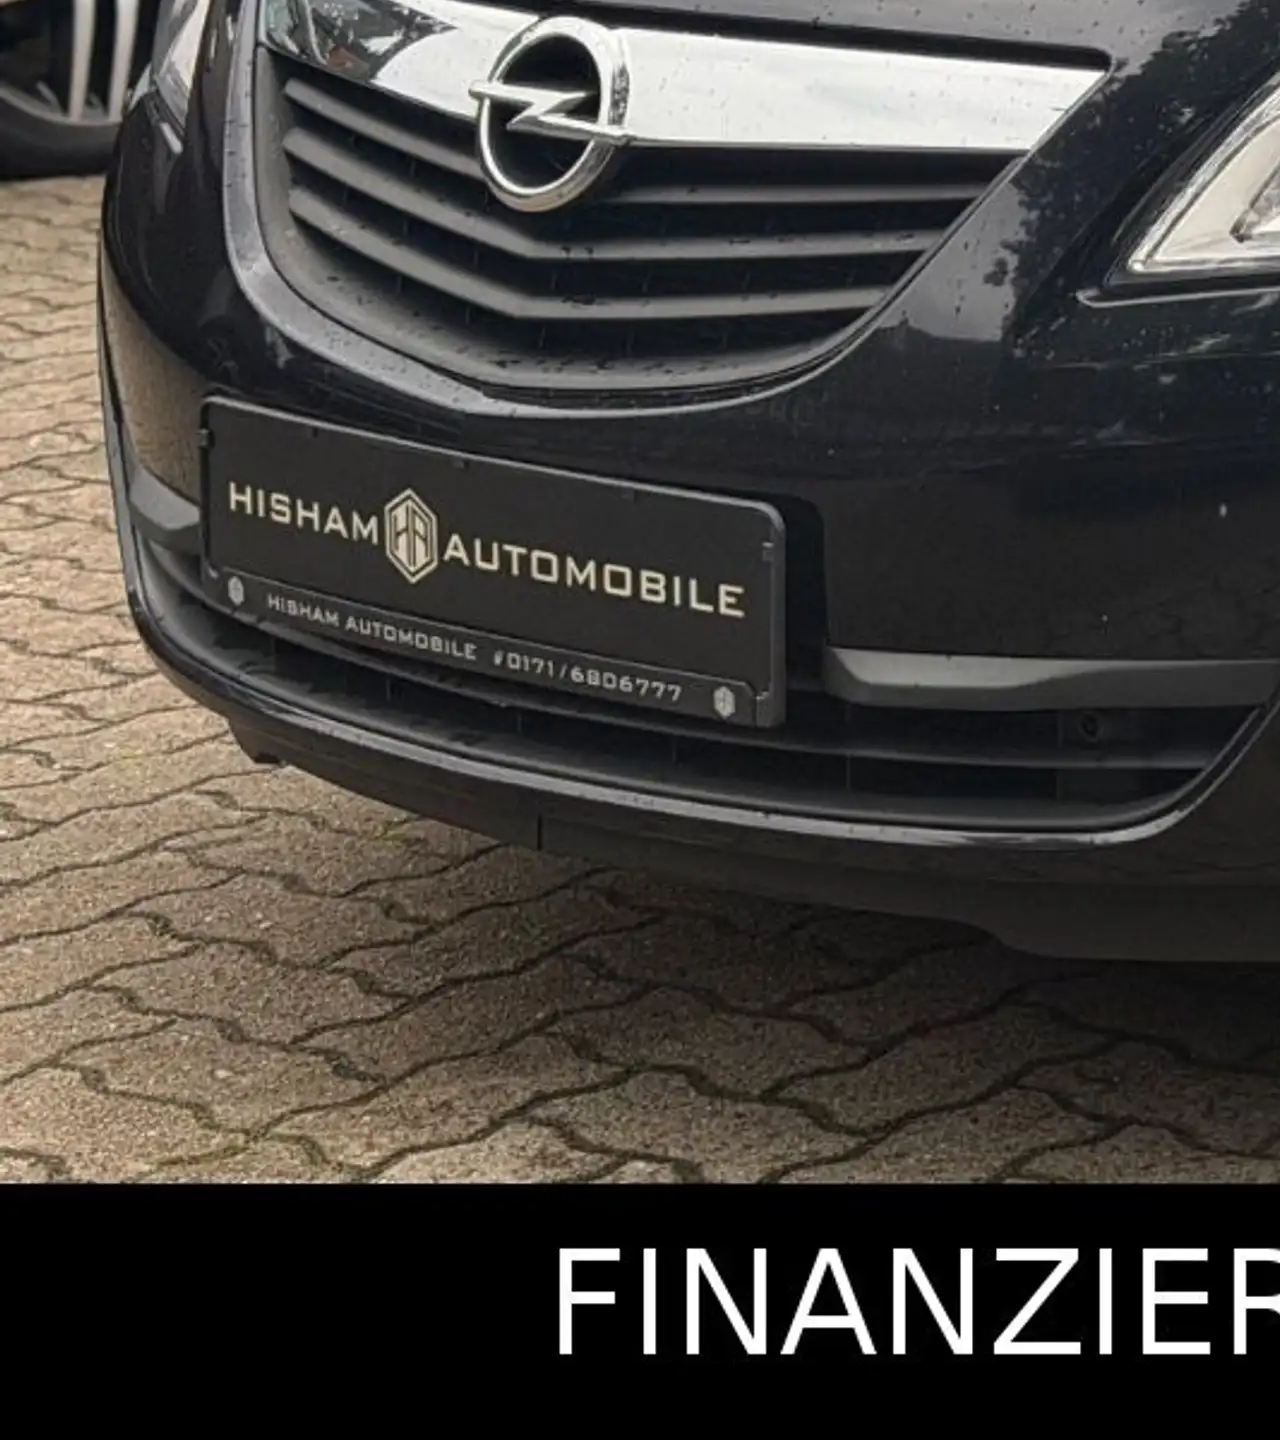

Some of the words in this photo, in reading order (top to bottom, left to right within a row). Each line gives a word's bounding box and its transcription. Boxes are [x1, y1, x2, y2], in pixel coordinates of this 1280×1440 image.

[228, 481, 379, 546] HISHAM
[443, 532, 746, 618] AUTOMOBILE
[267, 593, 340, 628] HISHAM
[345, 615, 477, 661] AUTOMOBILE
